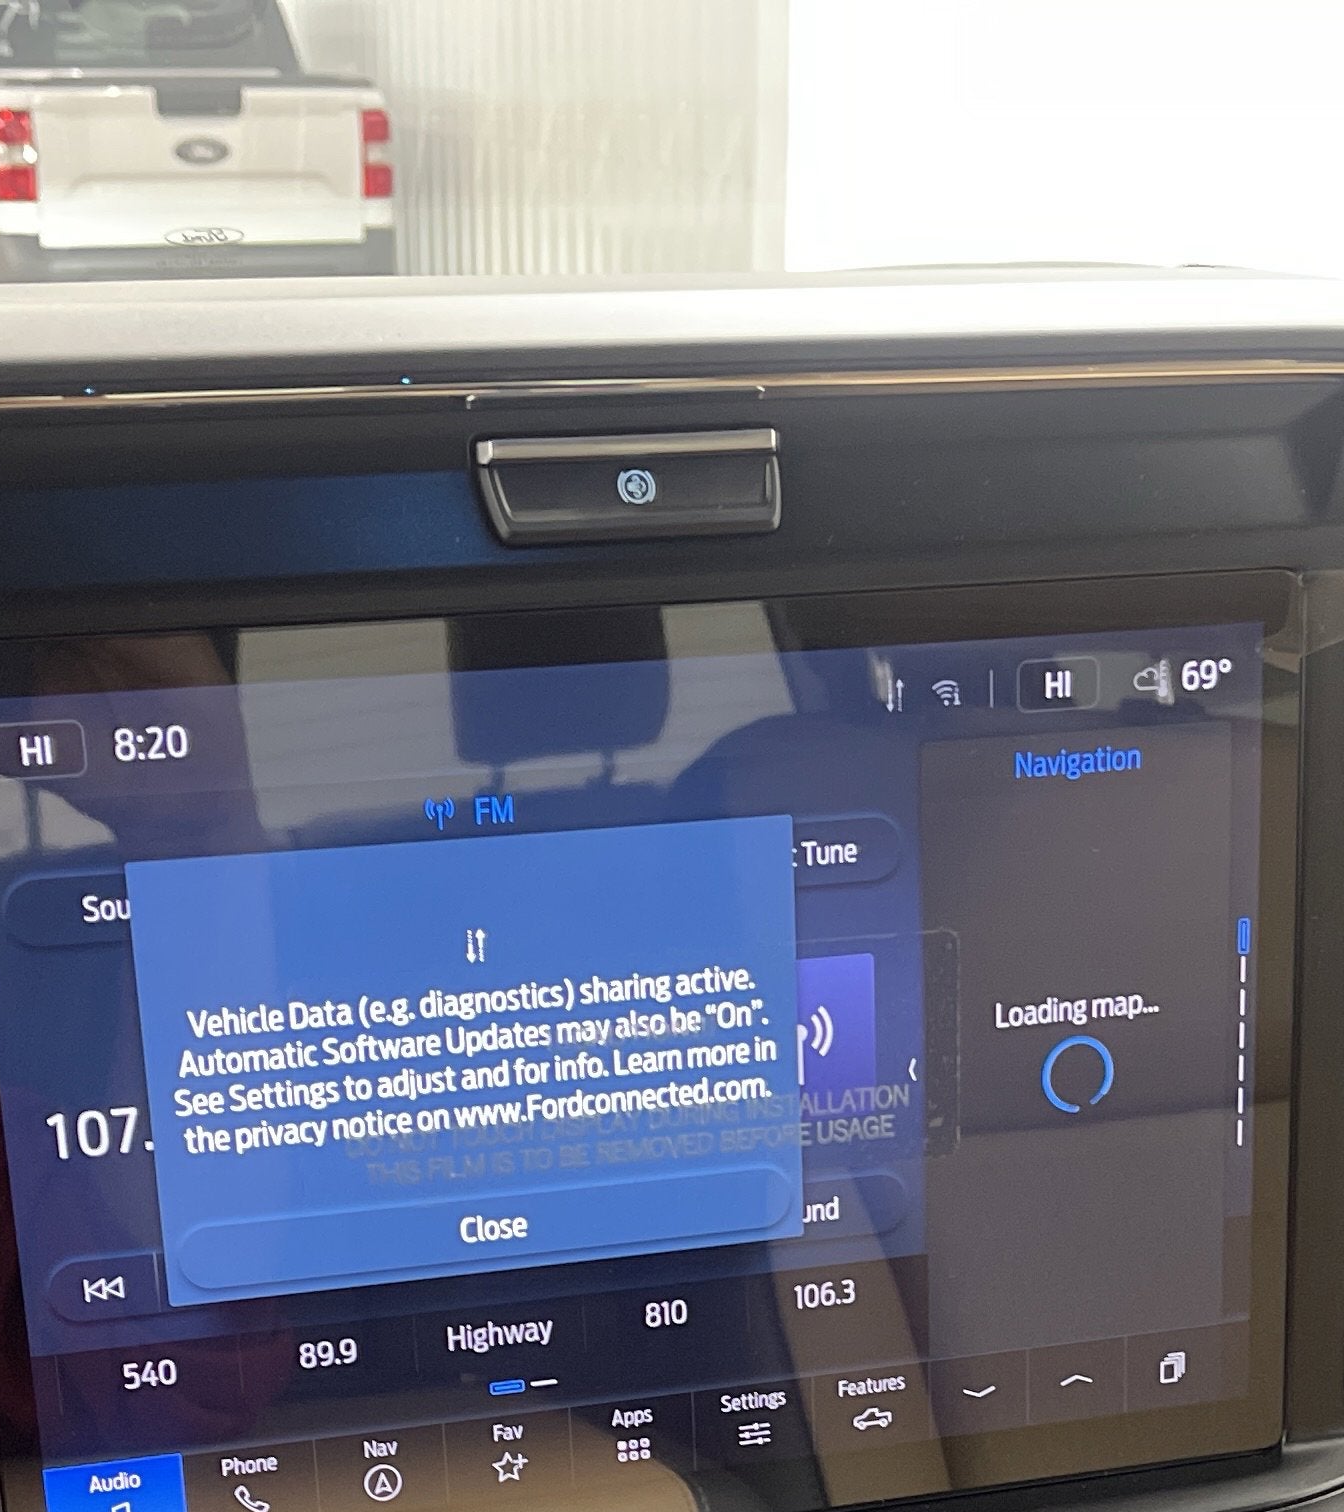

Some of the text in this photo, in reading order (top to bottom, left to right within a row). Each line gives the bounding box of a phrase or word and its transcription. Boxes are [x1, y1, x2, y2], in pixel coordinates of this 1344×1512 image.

[1044, 670, 1072, 699] HI
[1181, 657, 1233, 692] 69°
[19, 735, 53, 766] HI
[113, 724, 190, 763] 8:20
[1014, 746, 1142, 779] Navigation
[474, 795, 515, 827] FM
[801, 840, 859, 867] Tune
[186, 965, 756, 1038] Vehicle Data (e.g. diagnostics) sharing active.
[994, 993, 1160, 1029] Loading map...
[178, 1040, 319, 1078] Automatic
[321, 1034, 442, 1066] Software
[444, 1021, 551, 1058] Updates
[556, 1018, 610, 1046] may
[614, 1010, 666, 1039] also
[669, 1006, 702, 1032] be
[173, 1035, 777, 1118] See Settings to adjust and for info. Learn more in
[183, 1077, 773, 1156] the privacy notice on www.Fordconnected.com.
[745, 1083, 910, 1121] INSTALLATION
[815, 1113, 896, 1145] USAGE
[459, 1214, 529, 1244] Close
[793, 1277, 856, 1310] 106.3
[644, 1298, 689, 1329] 810
[446, 1320, 554, 1353] Highway
[298, 1337, 358, 1370] 89.9
[122, 1358, 178, 1390] 540
[837, 1373, 907, 1398] Features
[611, 1406, 654, 1428] Apps
[720, 1388, 787, 1414] Settings
[492, 1422, 525, 1442] Fav
[362, 1438, 398, 1459] Nav
[221, 1453, 278, 1478] Phone
[88, 1472, 142, 1494] Audio
